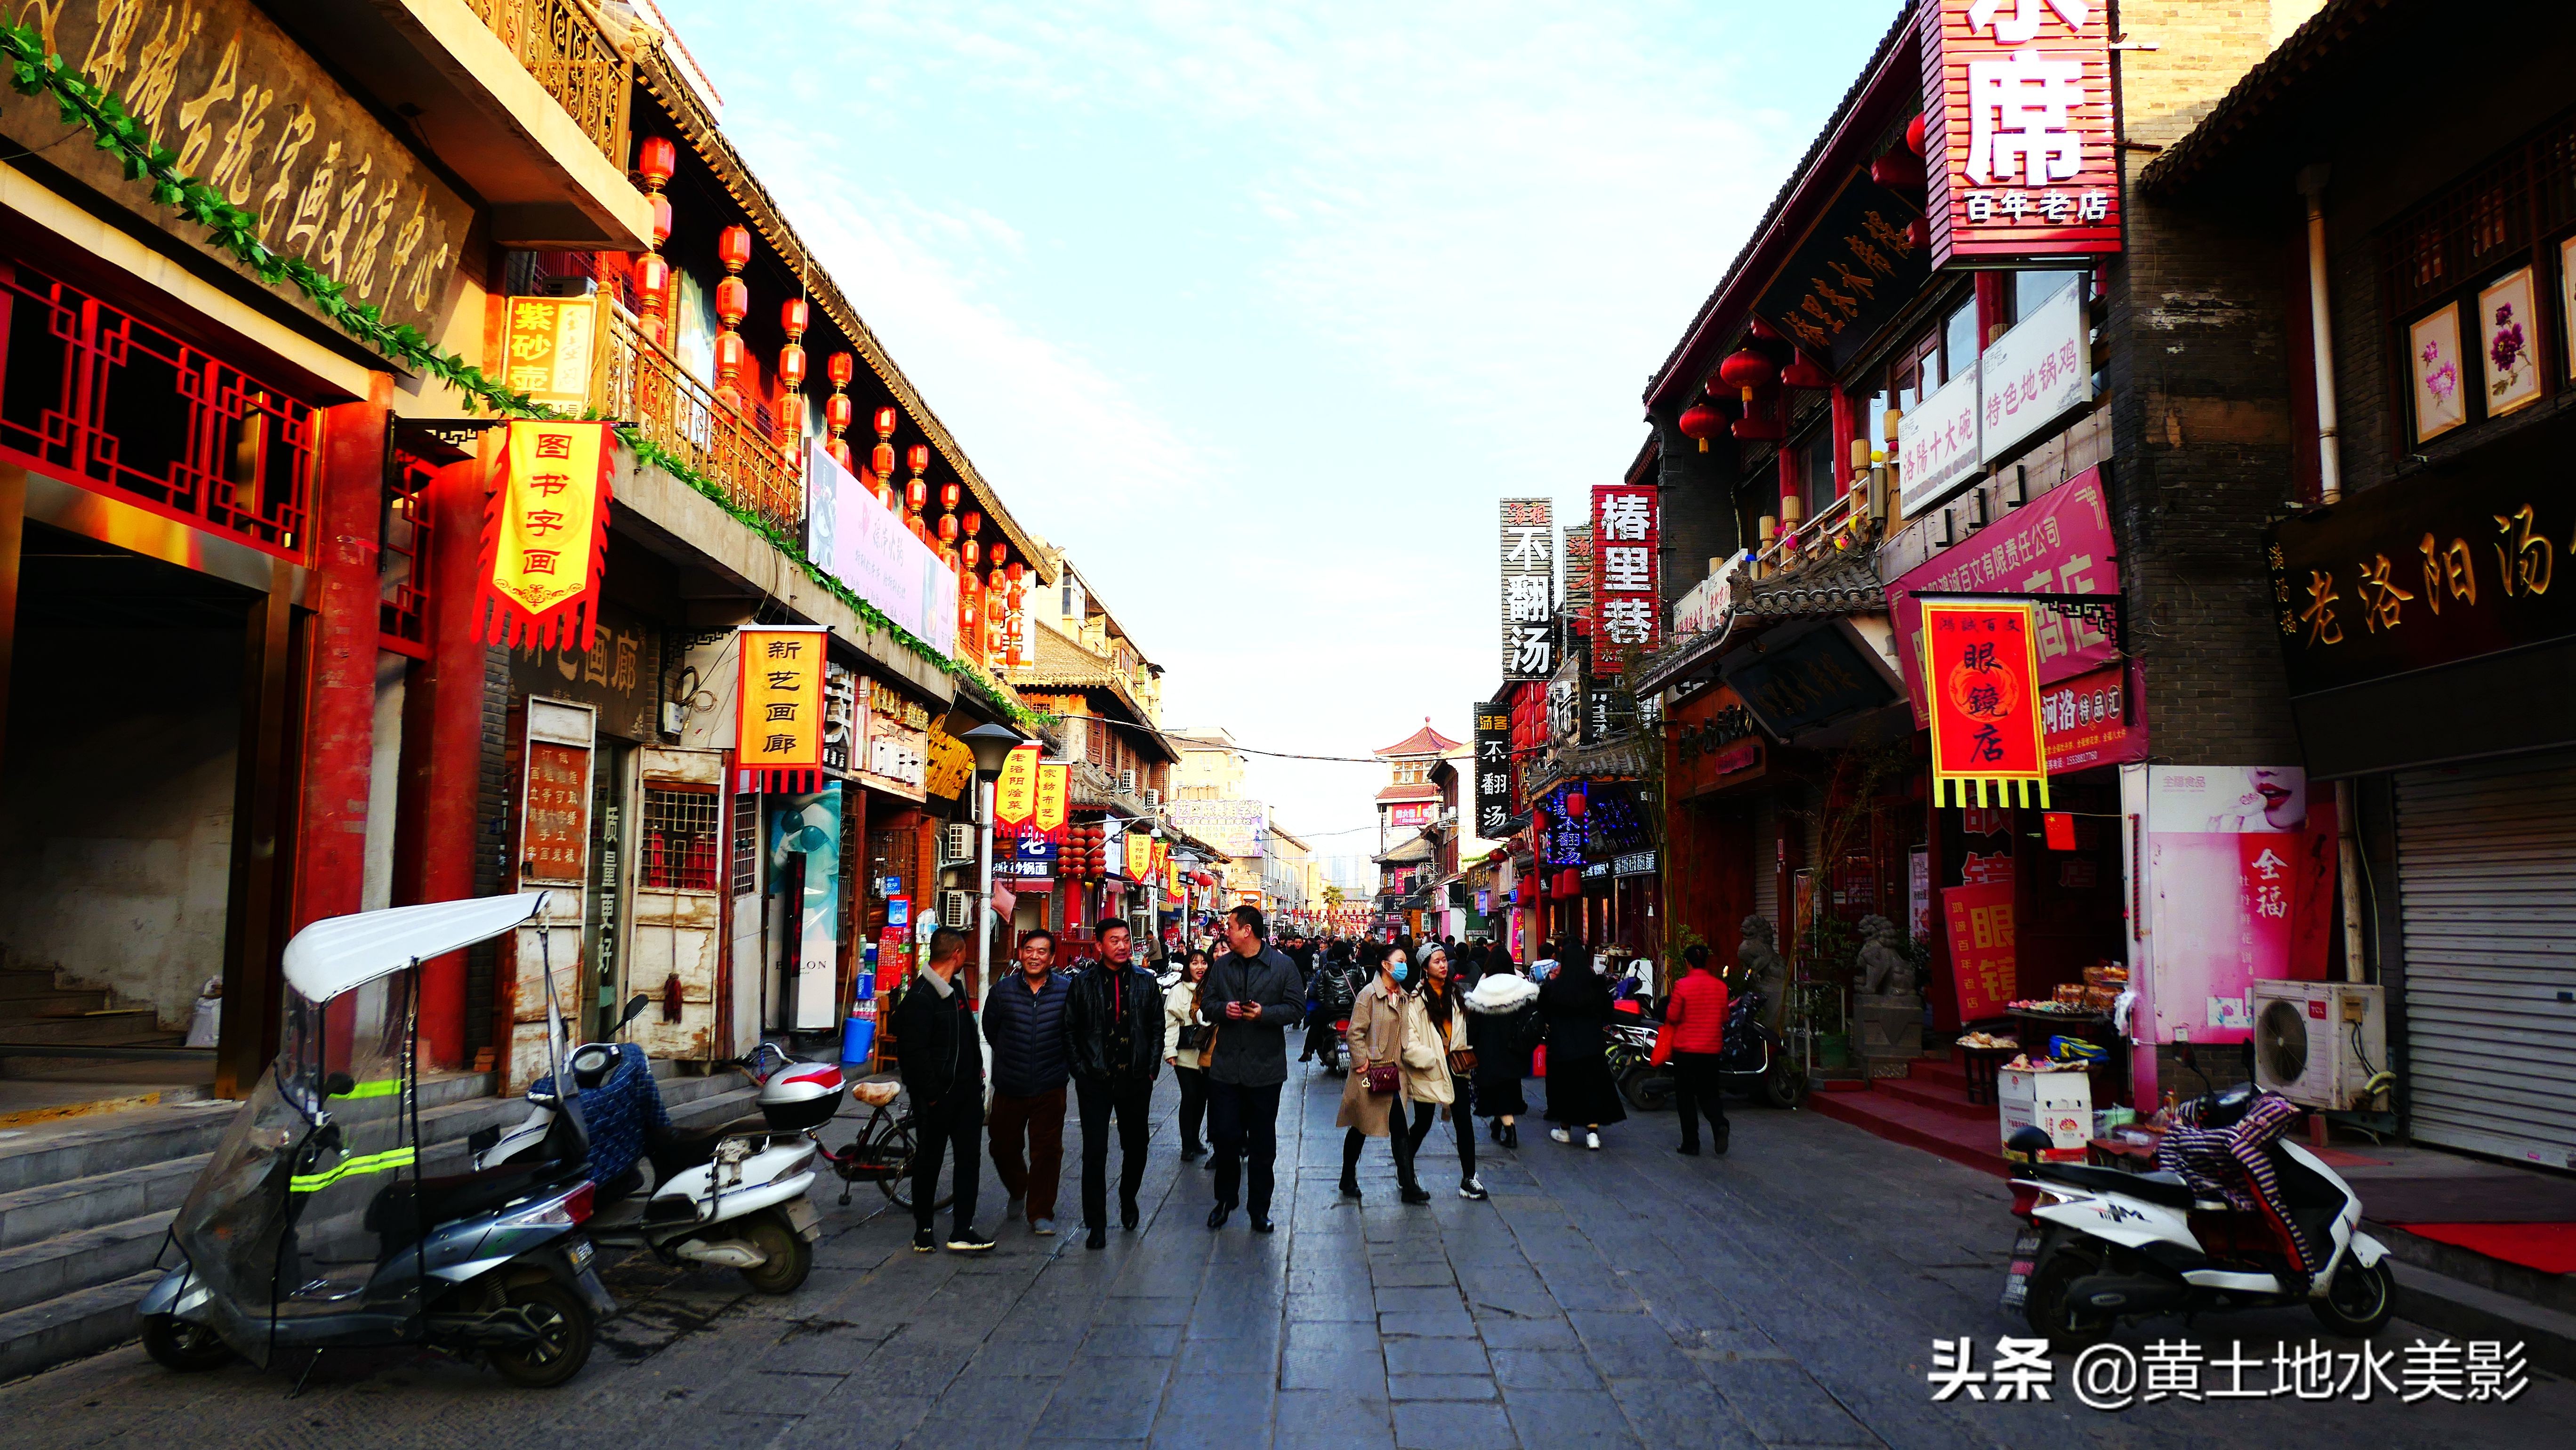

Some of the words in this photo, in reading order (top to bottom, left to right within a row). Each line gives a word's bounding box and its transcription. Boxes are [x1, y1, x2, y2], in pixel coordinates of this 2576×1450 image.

[1964, 189, 2108, 222] 百年老店
[510, 303, 554, 392] 紫砂壶
[1986, 337, 2077, 429] 特色地锅鸡
[523, 434, 573, 576] 图书字画
[1602, 493, 1653, 644] 椿里巷
[1918, 516, 2061, 592] 鸿诚百文有限责任公司
[2300, 503, 2576, 650] 老洛阳汤
[1506, 527, 1550, 674] 不翻汤
[763, 640, 803, 755] 新艺画廊
[1479, 716, 1507, 731] 汤客
[1007, 753, 1026, 810] 老洛阳烩菜
[1041, 769, 1056, 818] 家纺布艺
[1481, 741, 1507, 827] 不翻汤
[539, 830, 567, 841] 手工
[596, 806, 621, 975] 质量更好
[2252, 848, 2288, 918] 全福
[1970, 904, 2015, 1002] 眼镜
